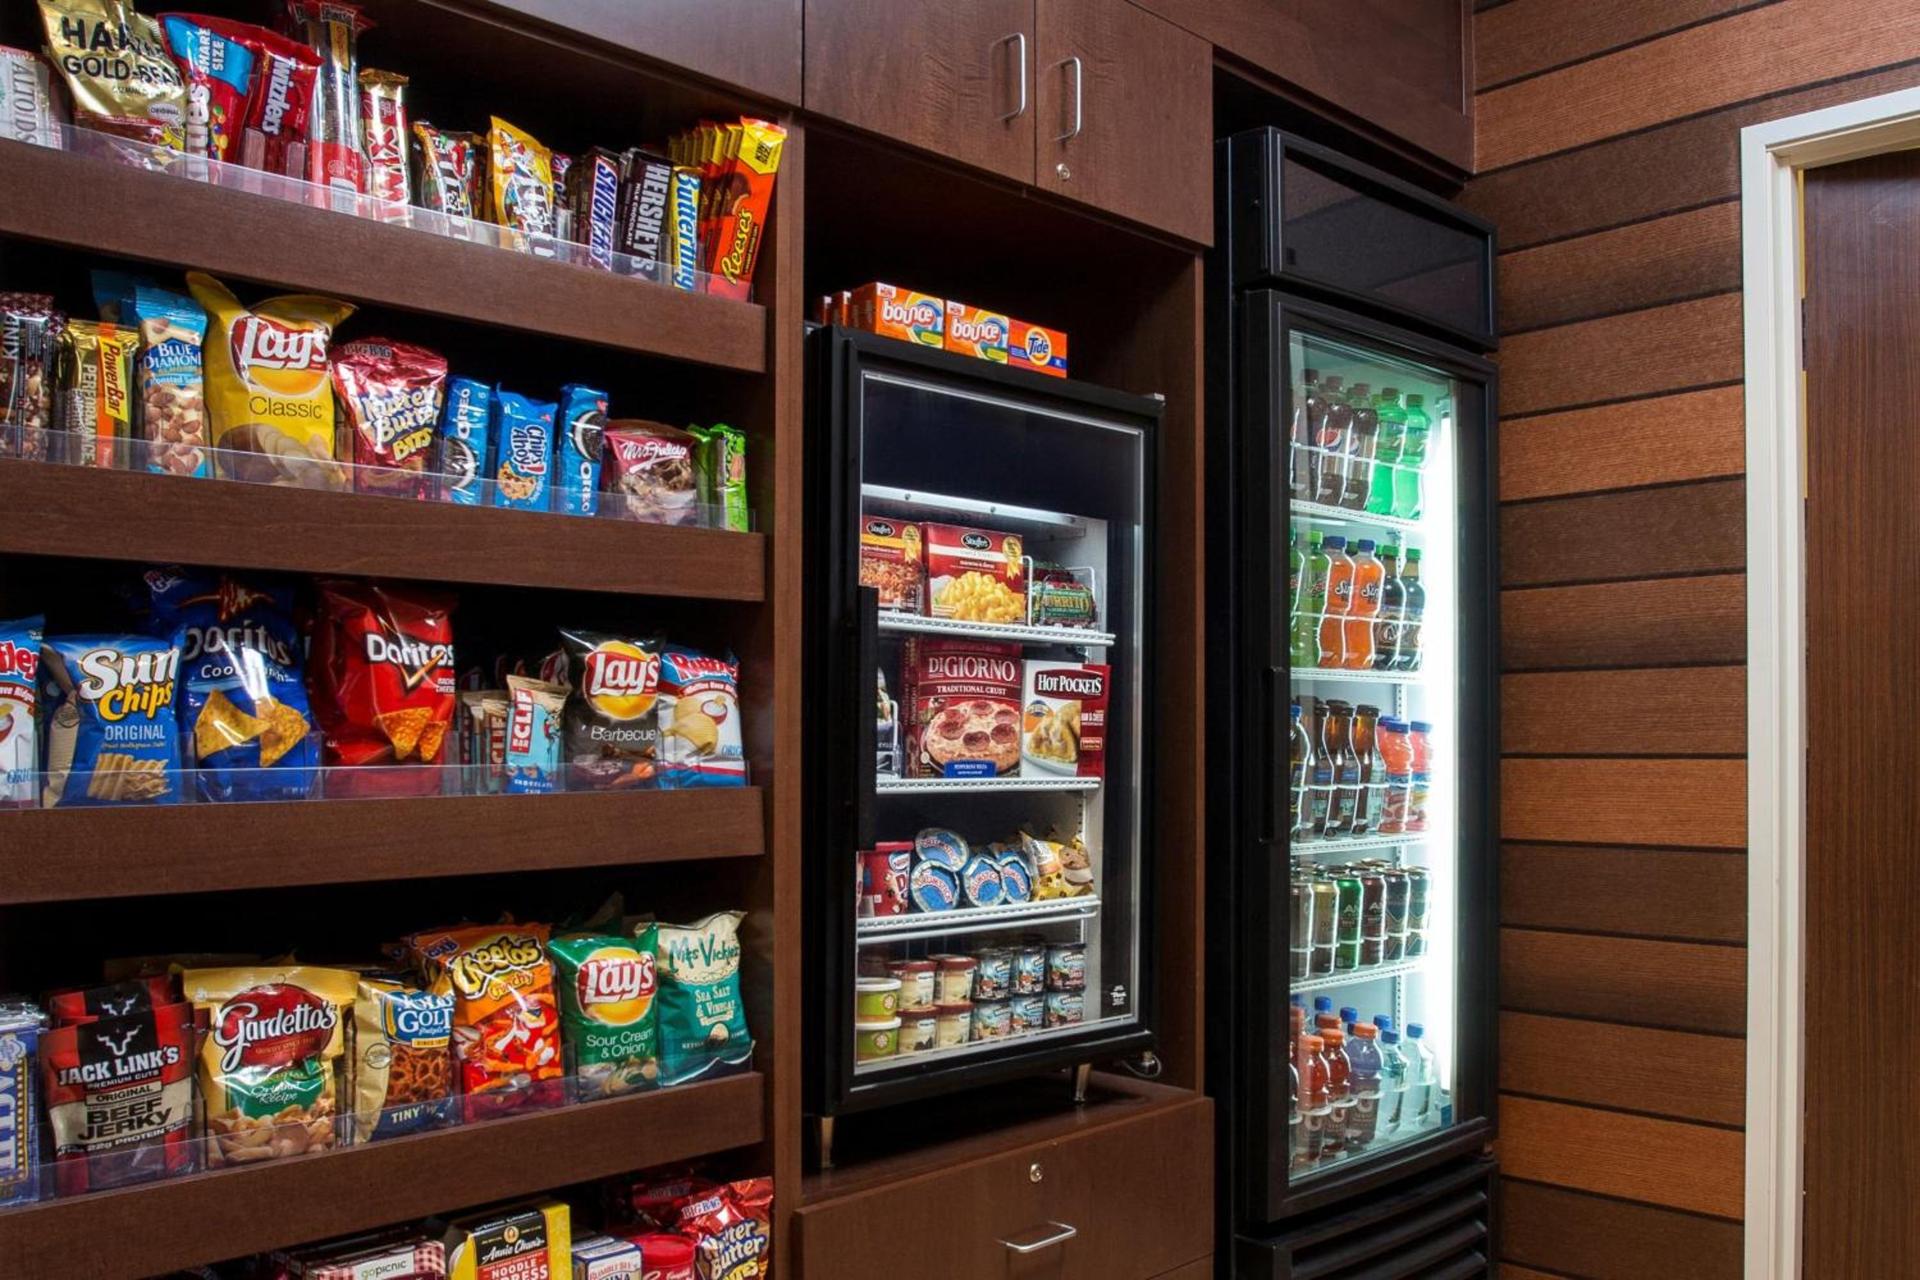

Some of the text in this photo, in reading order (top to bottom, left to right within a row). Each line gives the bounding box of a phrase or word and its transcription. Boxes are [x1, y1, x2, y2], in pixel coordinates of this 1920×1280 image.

[198, 28, 211, 74] SHARE
[212, 40, 225, 71] SIZE
[12, 61, 38, 144] ALTOIDS
[262, 57, 297, 135] Twizzlers
[592, 161, 617, 269] SNICKERS
[631, 164, 671, 271] HERSHEY'S
[674, 173, 700, 290] Butterfing
[721, 208, 752, 285] Reese's
[882, 300, 934, 325] bounce
[239, 317, 330, 370] Lay's
[951, 318, 1000, 342] bounce
[1027, 337, 1049, 355] Tide
[158, 342, 192, 357] BLUE
[81, 364, 97, 461] PERFORMANCE
[249, 396, 323, 420] Classic
[457, 388, 471, 439] OREO
[581, 461, 592, 512] OREO
[366, 633, 455, 667] Doritos
[79, 648, 180, 701] Sun
[590, 653, 660, 696] Lay's
[937, 685, 1006, 696] TRADITIONAL CRUST
[1037, 674, 1103, 694] HOT POCKETS
[514, 690, 533, 739] CLIF
[104, 724, 166, 740] ORIGINAL
[512, 738, 530, 747] BAR
[590, 725, 657, 741] Barbecue
[452, 936, 543, 994] Cheetos
[584, 956, 654, 1004] Lay's
[214, 1000, 338, 1073] Gardetto's
[586, 1034, 617, 1048] Sour
[600, 1041, 647, 1059] & Onion
[59, 1046, 180, 1085] JACK LINK'S
[87, 1070, 160, 1089] PREMIUM CUTS
[95, 1085, 154, 1102] ORIGINAL
[77, 1107, 172, 1141] JERKY
[86, 1096, 163, 1125] BEEF
[391, 1106, 420, 1124] TINY
[114, 1128, 165, 1146] PROTEIN
[682, 1203, 701, 1219] BIG
[360, 1259, 407, 1280] gopicnic
[491, 1258, 538, 1280] NOODLE
[710, 1236, 766, 1277] Butter
